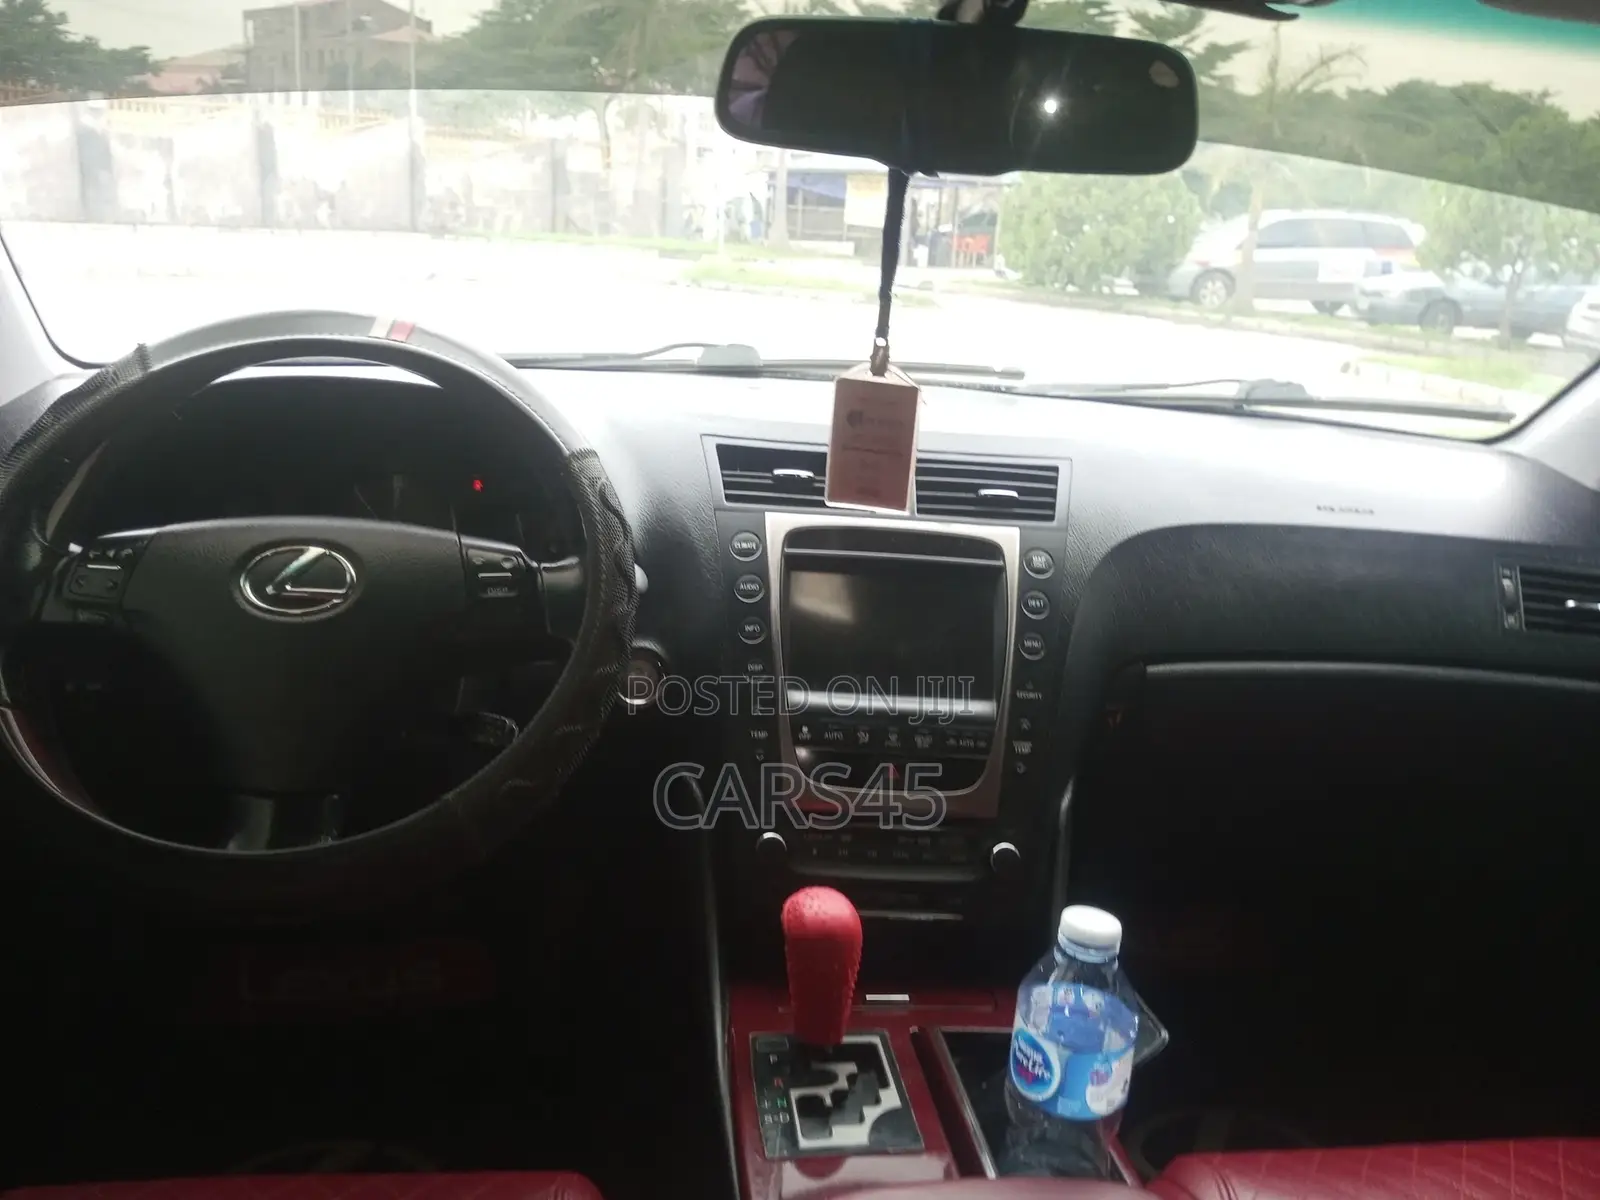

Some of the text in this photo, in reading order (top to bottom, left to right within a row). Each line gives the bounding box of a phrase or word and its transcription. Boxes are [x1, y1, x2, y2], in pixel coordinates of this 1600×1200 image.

[739, 582, 759, 591] AUDIO
[744, 624, 760, 633] INFO
[1023, 639, 1041, 649] MENU
[824, 731, 844, 741] AUTO
[777, 1097, 787, 1109] N
